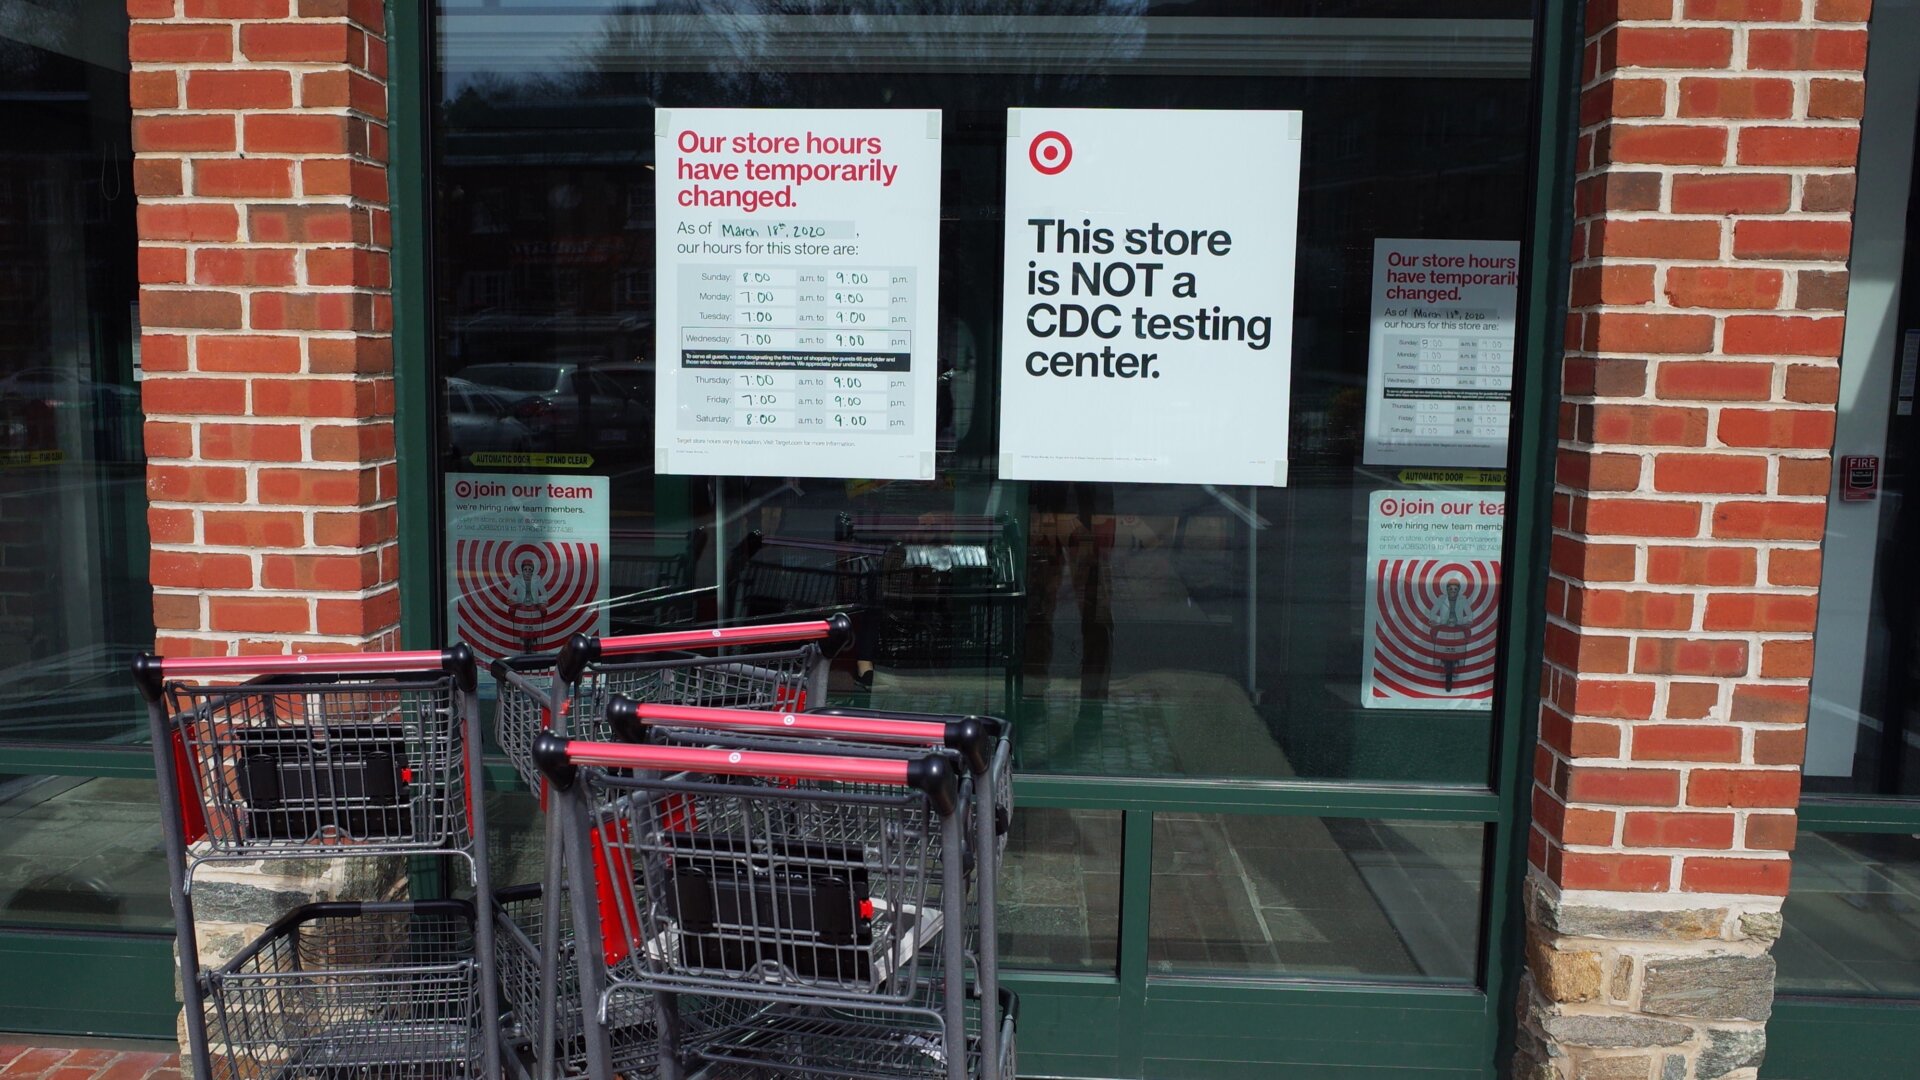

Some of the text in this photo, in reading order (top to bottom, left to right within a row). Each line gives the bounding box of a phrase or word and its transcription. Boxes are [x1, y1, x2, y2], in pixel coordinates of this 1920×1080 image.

[678, 130, 882, 154] Our store hours
[678, 158, 898, 186] have temporarily
[678, 185, 796, 212] changed.
[677, 222, 695, 234] As
[699, 222, 712, 234] of
[722, 224, 758, 237] March
[794, 226, 825, 237] 2020
[1028, 219, 1232, 256] This store
[677, 242, 858, 255] our hours for this store are:
[1388, 252, 1516, 268] Our store hours
[702, 273, 732, 282] Sunday:
[1028, 261, 1197, 298] is NOT a
[1387, 269, 1425, 283] have
[700, 292, 732, 302] Monday:
[1386, 286, 1461, 303] changed.
[700, 312, 732, 322] Tuesday:
[1384, 308, 1396, 317] As
[1399, 308, 1408, 317] of
[1414, 309, 1441, 318] March
[1027, 303, 1272, 350] CDC testing
[1401, 320, 1426, 329] hours
[1428, 321, 1440, 329] for
[1441, 321, 1456, 329] this
[1458, 322, 1481, 330] store
[686, 334, 732, 344] Wednesday:
[1025, 346, 1160, 378] center.
[696, 376, 732, 386] Thursday:
[890, 380, 905, 388] p.m.
[706, 395, 731, 405] Friday:
[696, 414, 732, 424] Saturday:
[477, 455, 512, 464] AUTOMATIC
[546, 456, 565, 464] STAND
[568, 456, 587, 464] CLEAR
[1850, 458, 1875, 468] FIRE
[1406, 472, 1444, 481] AUTOMATIC
[1445, 473, 1464, 481] DOOR
[1480, 474, 1501, 482] STAND
[474, 481, 593, 499] join our team
[479, 504, 501, 512] hiring
[1400, 499, 1504, 517] join our tea
[1406, 522, 1428, 531] hiring
